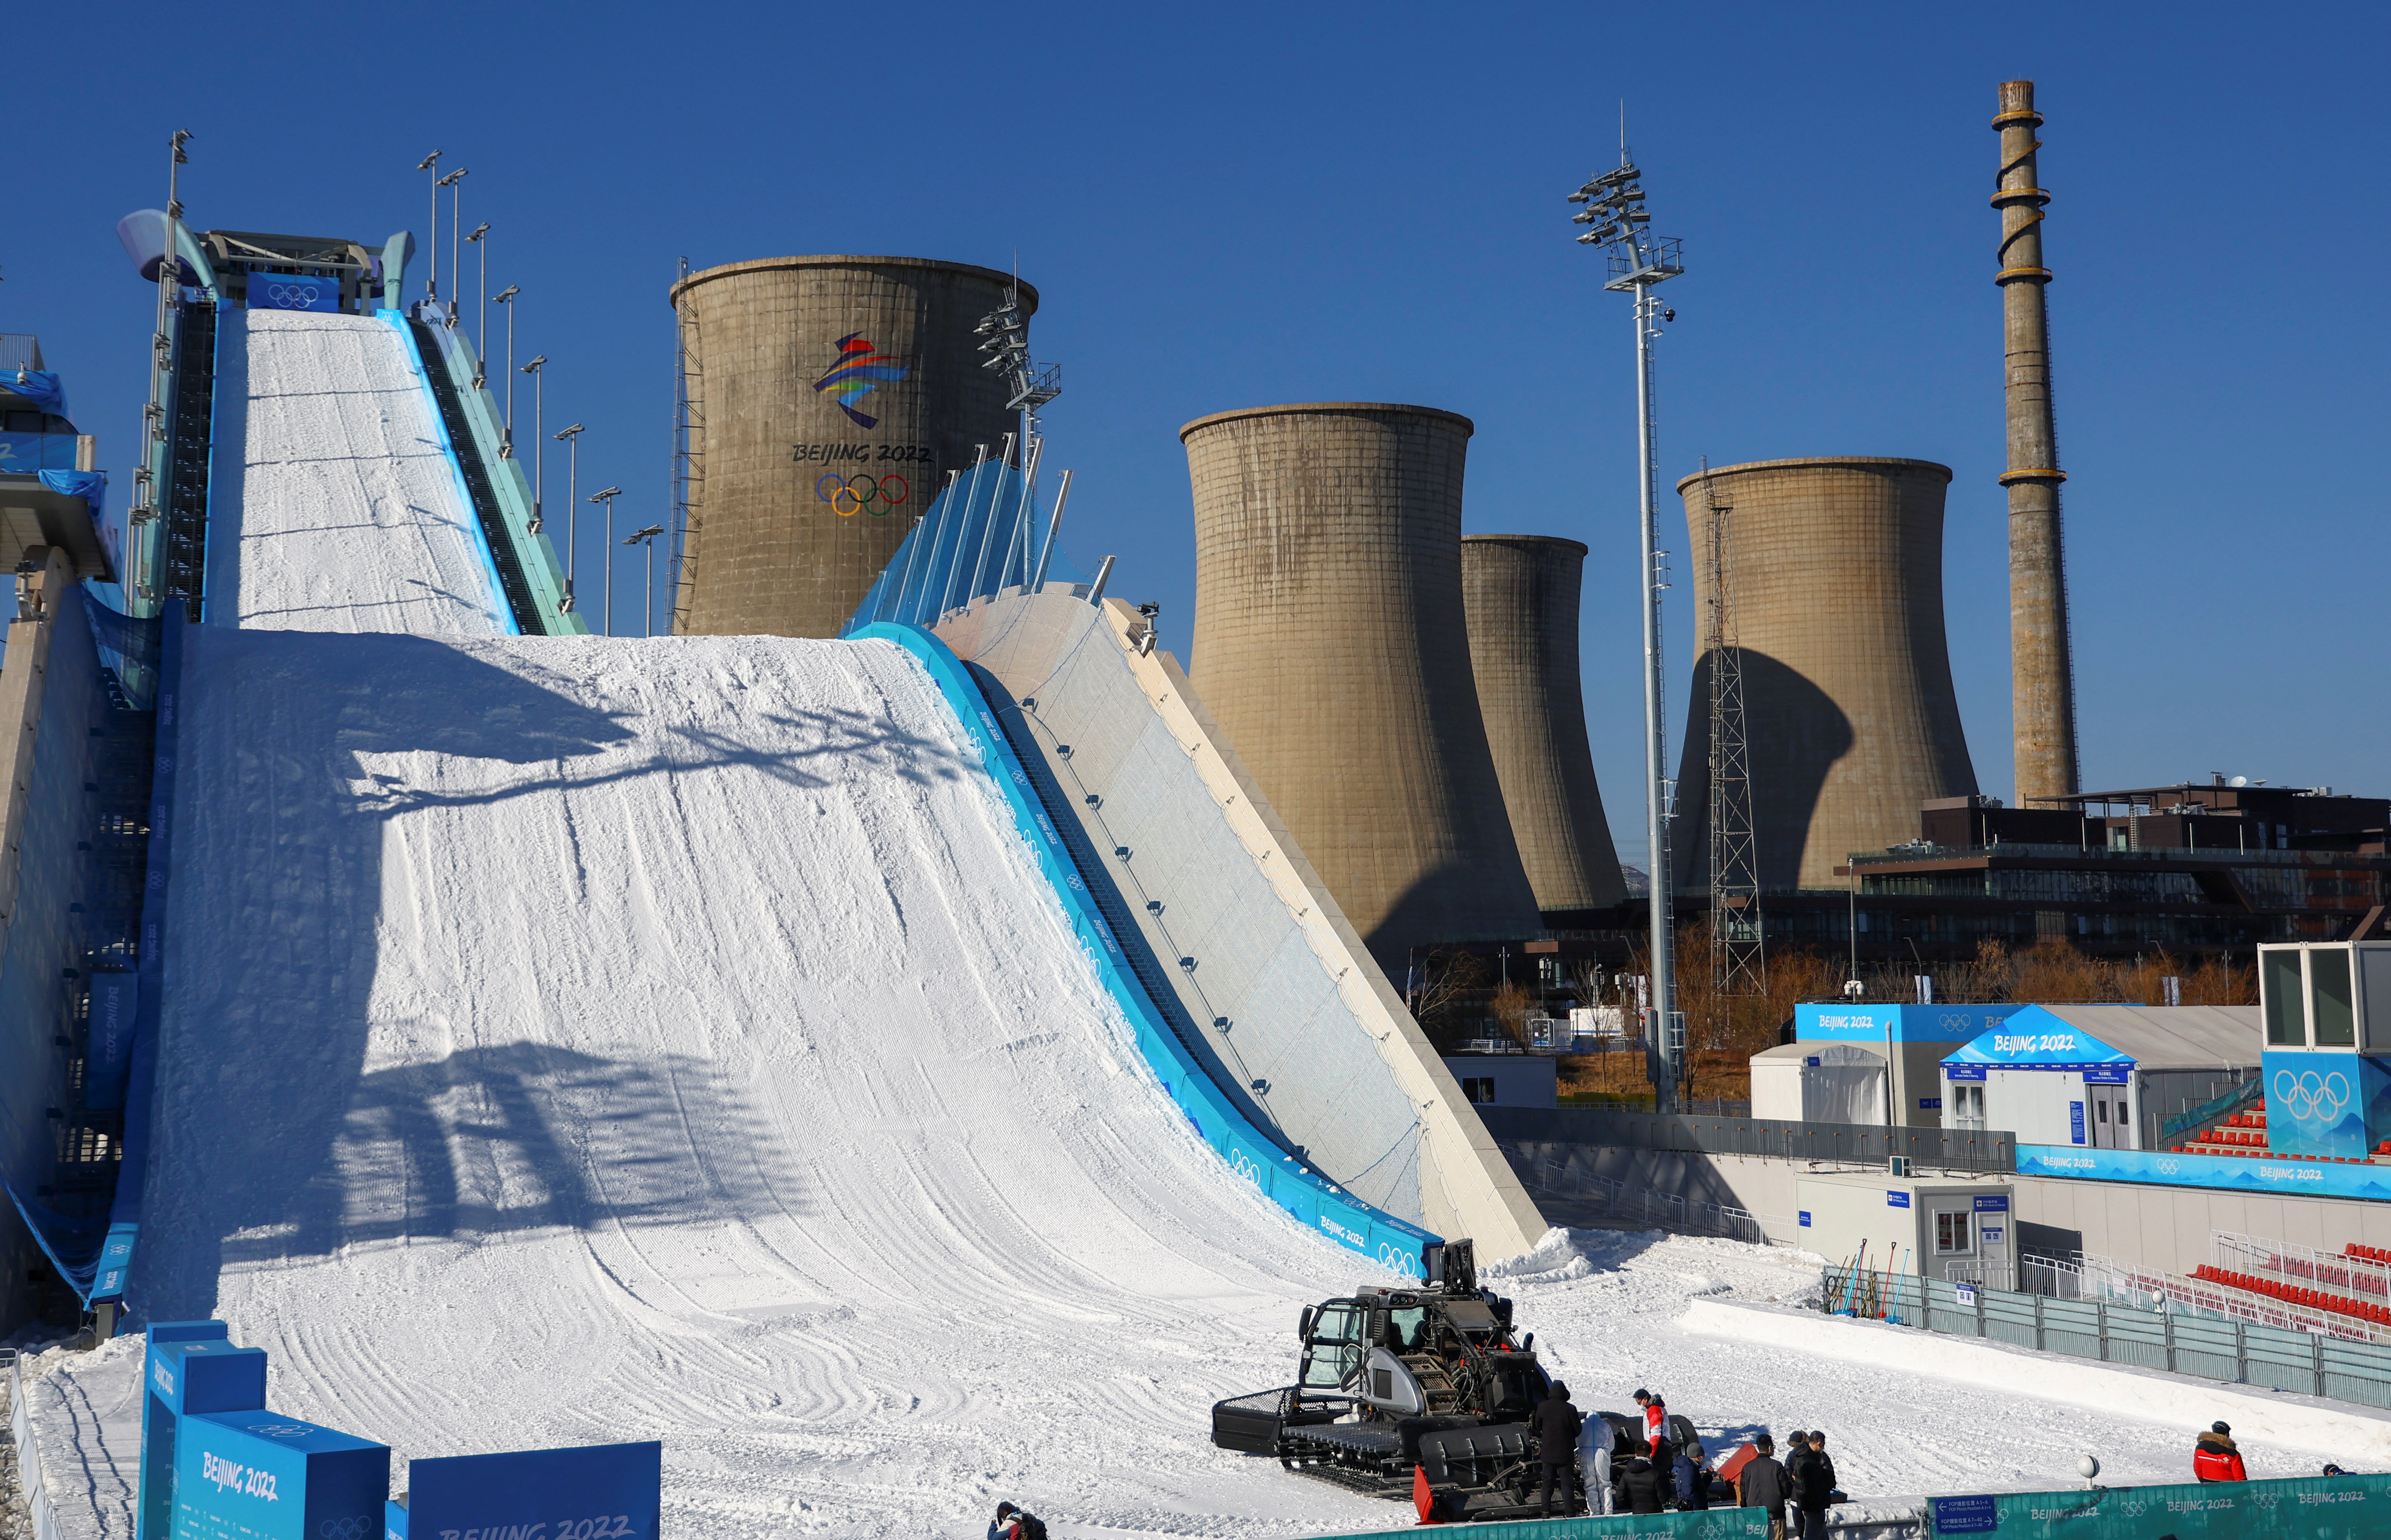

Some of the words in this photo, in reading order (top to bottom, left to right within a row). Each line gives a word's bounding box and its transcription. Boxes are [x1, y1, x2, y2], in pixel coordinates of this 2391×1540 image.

[793, 444, 870, 466] BEIJING
[876, 445, 935, 464] 2022
[980, 712, 991, 728] BEIJING
[989, 726, 1001, 742] 2022
[1036, 814, 1050, 833] BEIJING
[1046, 831, 1058, 845] 2022
[1093, 919, 1105, 942] BEIJING
[1103, 937, 1116, 954] 2022
[104, 986, 119, 1029] BEIJING
[1819, 1015, 1848, 1031] BEIJING
[1851, 1016, 1874, 1028] 2022
[1985, 1016, 2007, 1028] BE
[105, 1032, 117, 1064] 2022
[1994, 1035, 2036, 1056] BEIJING
[2039, 1034, 2077, 1051] 2022
[2043, 1156, 2071, 1169] BEIJING
[2074, 1158, 2096, 1168] 2022
[2260, 1166, 2294, 1181] BEIJING
[2297, 1169, 2324, 1180] 2022
[1320, 1215, 1345, 1238] BEIJING
[1347, 1229, 1365, 1247] 2022
[1385, 1219, 1409, 1230] BEIJING
[1405, 1228, 1425, 1237] 2022
[203, 1452, 244, 1494] BEIJING
[245, 1467, 279, 1502] 2022
[2167, 1500, 2203, 1514] BEIJING
[2207, 1498, 2235, 1509] 2022
[2298, 1493, 2335, 1507] BEIJING
[2338, 1491, 2367, 1502] 2022
[2030, 1508, 2070, 1522] BEIJING
[2072, 1506, 2100, 1517] 2022
[555, 1515, 637, 1540] 2022
[1646, 1531, 1676, 1540] 2022
